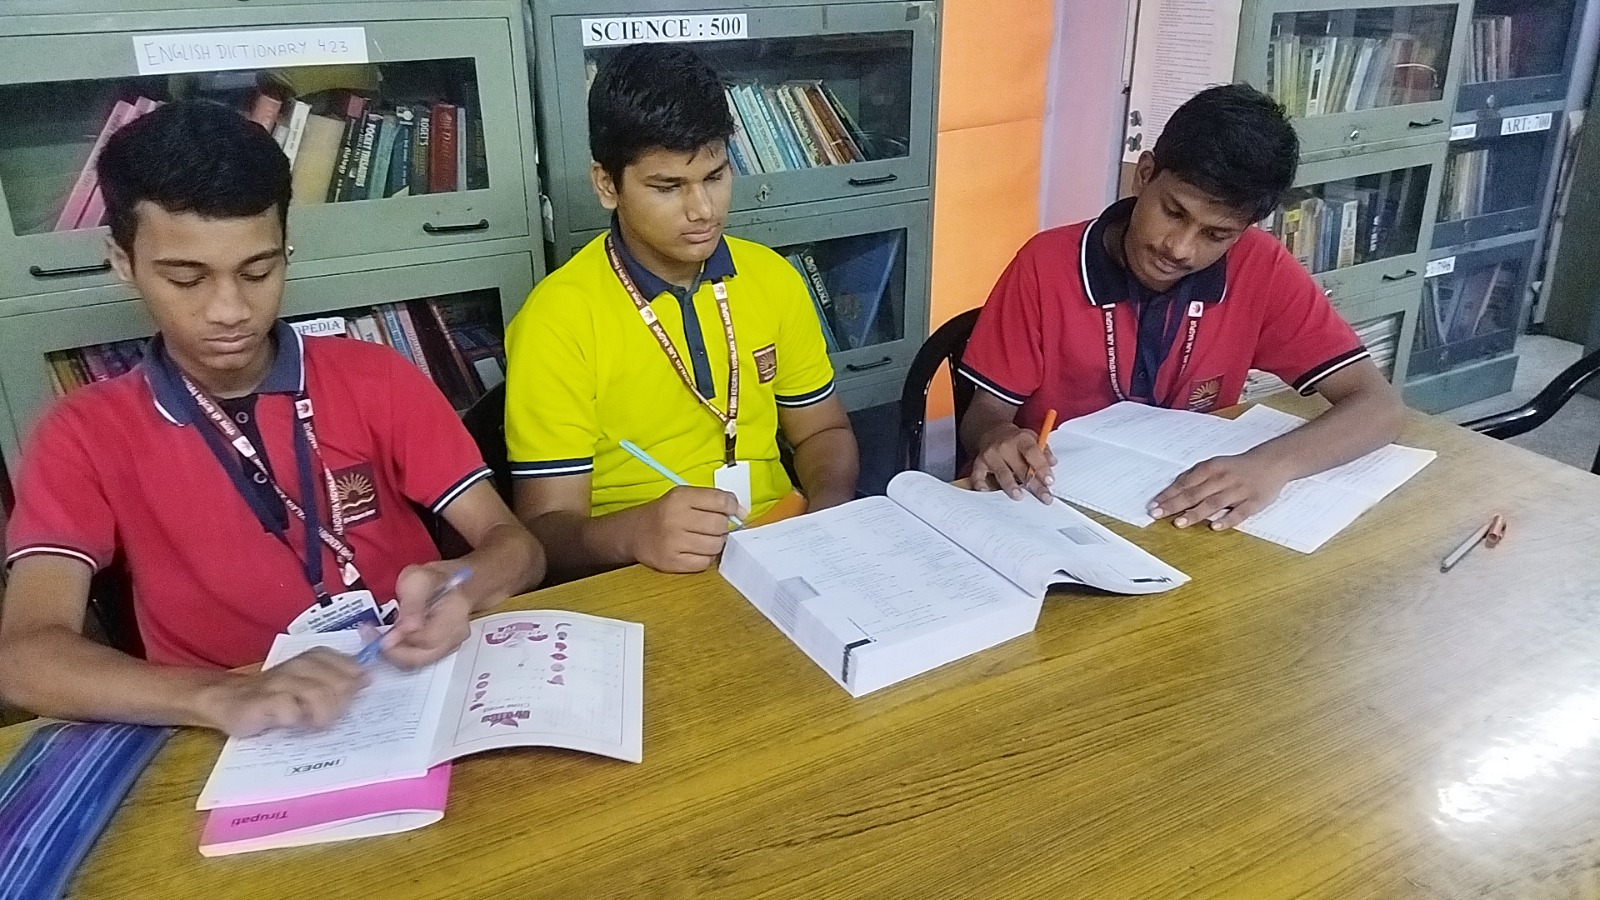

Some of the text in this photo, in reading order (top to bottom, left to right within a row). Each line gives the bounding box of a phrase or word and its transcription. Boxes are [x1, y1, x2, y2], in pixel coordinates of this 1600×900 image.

[591, 18, 691, 41] SCIENCE
[710, 17, 741, 35] 500
[144, 39, 348, 66] ENGLISH DICTIONARY 423
[363, 122, 376, 150] POCKET
[303, 422, 318, 449] NAGPUR
[291, 758, 342, 774] INDEX
[231, 811, 289, 827] Tirupati
